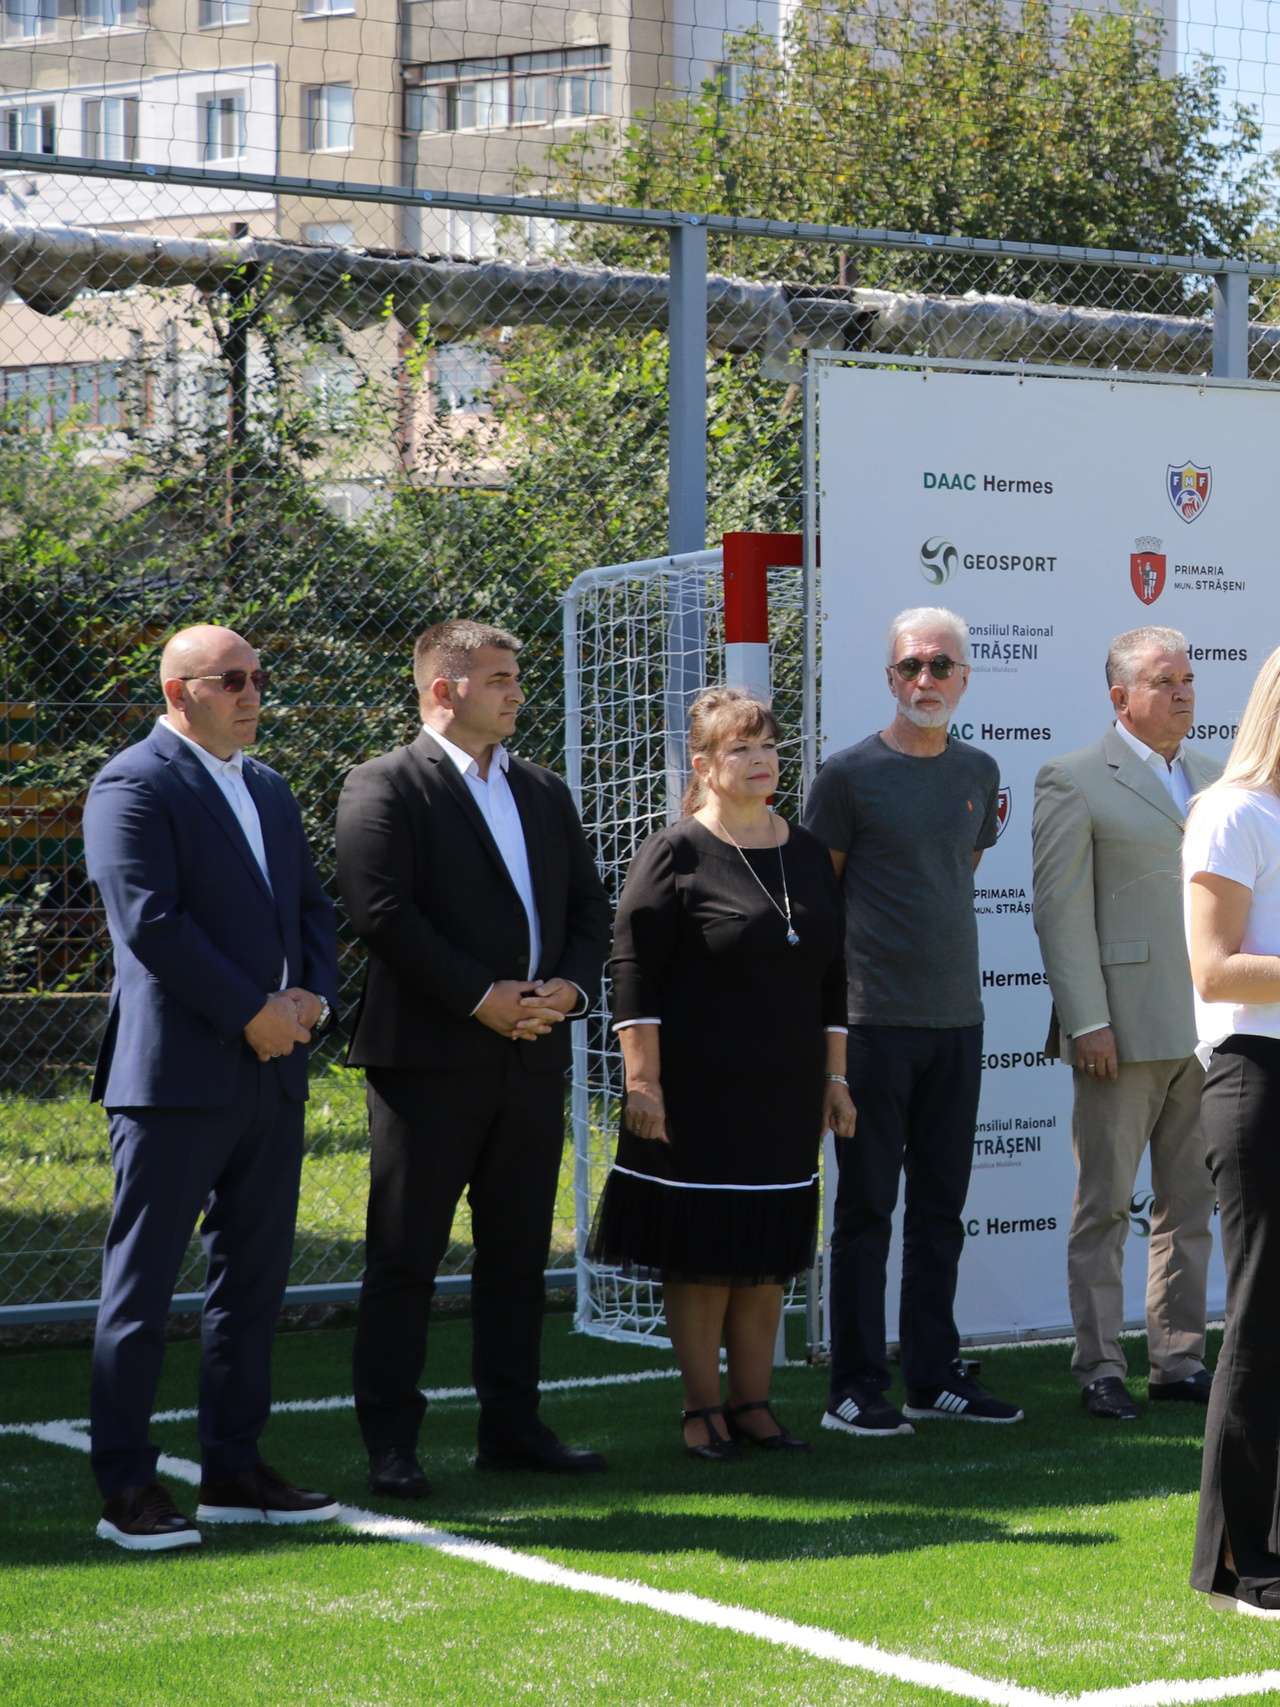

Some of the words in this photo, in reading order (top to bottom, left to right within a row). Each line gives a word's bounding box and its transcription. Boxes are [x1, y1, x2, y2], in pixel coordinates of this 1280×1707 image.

[923, 472, 976, 491] DAAC
[983, 474, 1053, 494] Hermes
[1173, 475, 1206, 487] FMF
[963, 554, 1057, 572] GEOSPORT
[1174, 565, 1224, 575] PRIMARIA
[1174, 582, 1194, 590] MUN.
[966, 624, 1009, 636] onsiliul
[1012, 625, 1053, 636] Raional
[970, 640, 1038, 664] TRĂȘENI
[949, 723, 974, 740] AC
[981, 723, 1051, 740] Hermes
[974, 888, 1026, 899] PRIMARIA
[974, 1118, 1013, 1133] onsiliul
[1015, 1115, 1056, 1129] Raional
[974, 1135, 1041, 1158] TRĂȘENI
[987, 1217, 1057, 1235] Hermes
